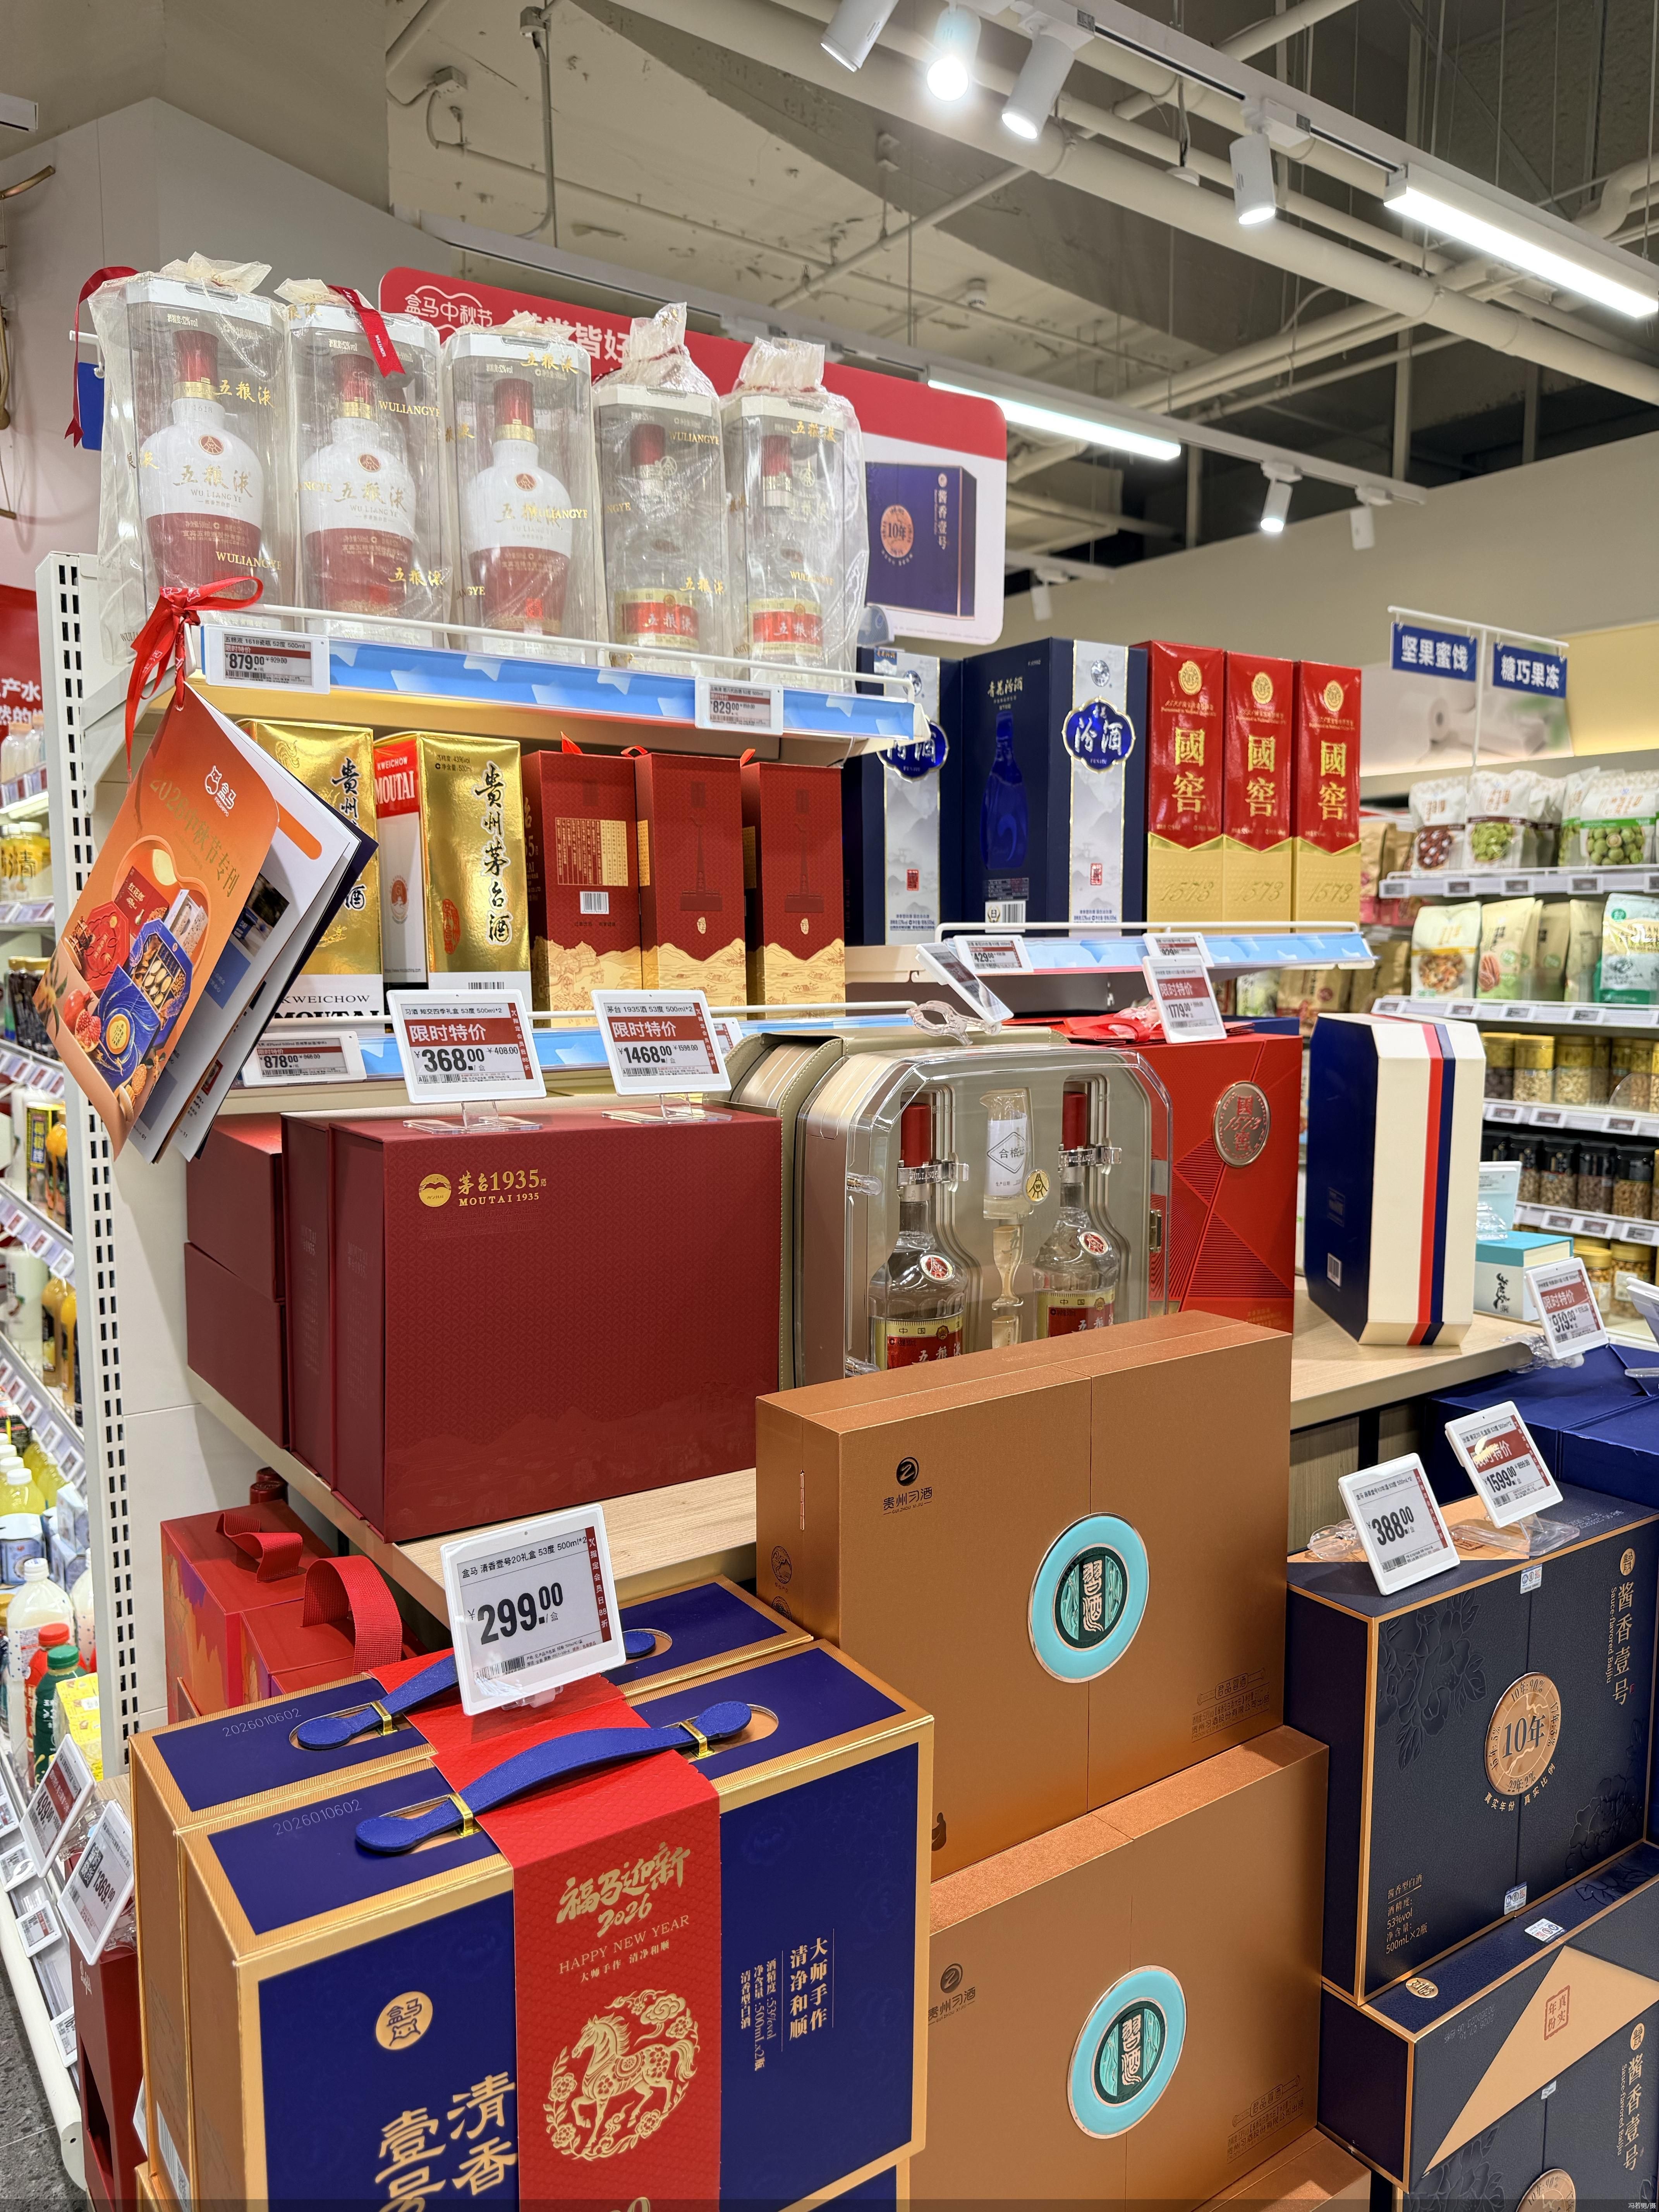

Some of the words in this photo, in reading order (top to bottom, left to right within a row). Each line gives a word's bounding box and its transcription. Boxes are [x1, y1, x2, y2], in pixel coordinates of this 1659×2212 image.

[405, 293, 493, 327] 盒马中秋节
[375, 335, 386, 357] WULIANGYE
[520, 352, 579, 374] 五粮液
[193, 405, 212, 413] 1618
[215, 380, 275, 408] 五粮液
[173, 465, 254, 498] 五粮液
[334, 481, 407, 512] 五粮液
[215, 551, 282, 571] WULIANGYE
[225, 645, 251, 653] 限时特价
[1401, 635, 1469, 672] 坚果蜜饯
[1501, 655, 1560, 690] 糖巧果冻
[1074, 716, 1123, 755] 汾酒
[377, 756, 408, 771] KWEICHOW
[1172, 727, 1205, 813] 國窖
[1245, 735, 1275, 817] 國窖
[374, 771, 415, 805] MOUTAI
[1318, 740, 1346, 821] 國窖
[331, 757, 366, 911] 贵州酒
[474, 763, 512, 945] 贵州茅台酒
[1161, 882, 1214, 903] 1573
[1234, 882, 1283, 902] 1573
[1308, 883, 1353, 903] 1573
[1160, 983, 1192, 996] 限时特价
[409, 1024, 486, 1042] 限时特价
[611, 1021, 676, 1038] 限时特价
[1224, 1116, 1262, 1132] 1573
[459, 1195, 512, 1206] MOUTAI
[517, 1193, 539, 1201] 1935
[883, 1487, 933, 1510] 贵州习酒
[462, 1568, 477, 1578] 盒马
[481, 1551, 536, 1573] 清香壹号20礼盒
[538, 1545, 555, 1556] 53度
[1609, 1587, 1617, 1652] Sauce-flavored
[1612, 1582, 1634, 1705] 酱香壹号
[1511, 1678, 1544, 1702] 10年:90%
[223, 1708, 301, 1737] 2026010602
[1503, 1714, 1545, 1759] 10年
[1484, 1792, 1515, 1812] 真实年份
[1524, 1763, 1555, 1805] 真实比例
[1508, 1771, 1536, 1793] 22年:2%
[273, 1799, 362, 1835] 2026010602
[556, 1842, 690, 1923] 福马迎新
[1388, 1873, 1422, 1899] 酱香型白酒
[597, 1893, 653, 1937] 2026
[1387, 1908, 1412, 1929] 53%vol
[1388, 1897, 1412, 1917] 酒精度:
[560, 1945, 608, 1974] HAPPY
[613, 1932, 646, 1953] NEW
[651, 1915, 690, 1939] YEAR
[1387, 1923, 1412, 1943] 净含量:
[580, 1959, 622, 1983] 大师手作
[629, 1939, 669, 1964] 清净和顺
[741, 1970, 750, 2030] 清香型白酒
[789, 1945, 808, 2041] 清净和顺
[810, 1937, 827, 2031] 大师手作
[928, 1987, 975, 2020] 贵州习酒
[1548, 2001, 1556, 2032] 年份
[1558, 1994, 1566, 2025] 真实
[1619, 2064, 1627, 2128] Sauce-flavored
[1623, 2053, 1643, 2170] 酱香壹号
[448, 2072, 518, 2195] 清香
